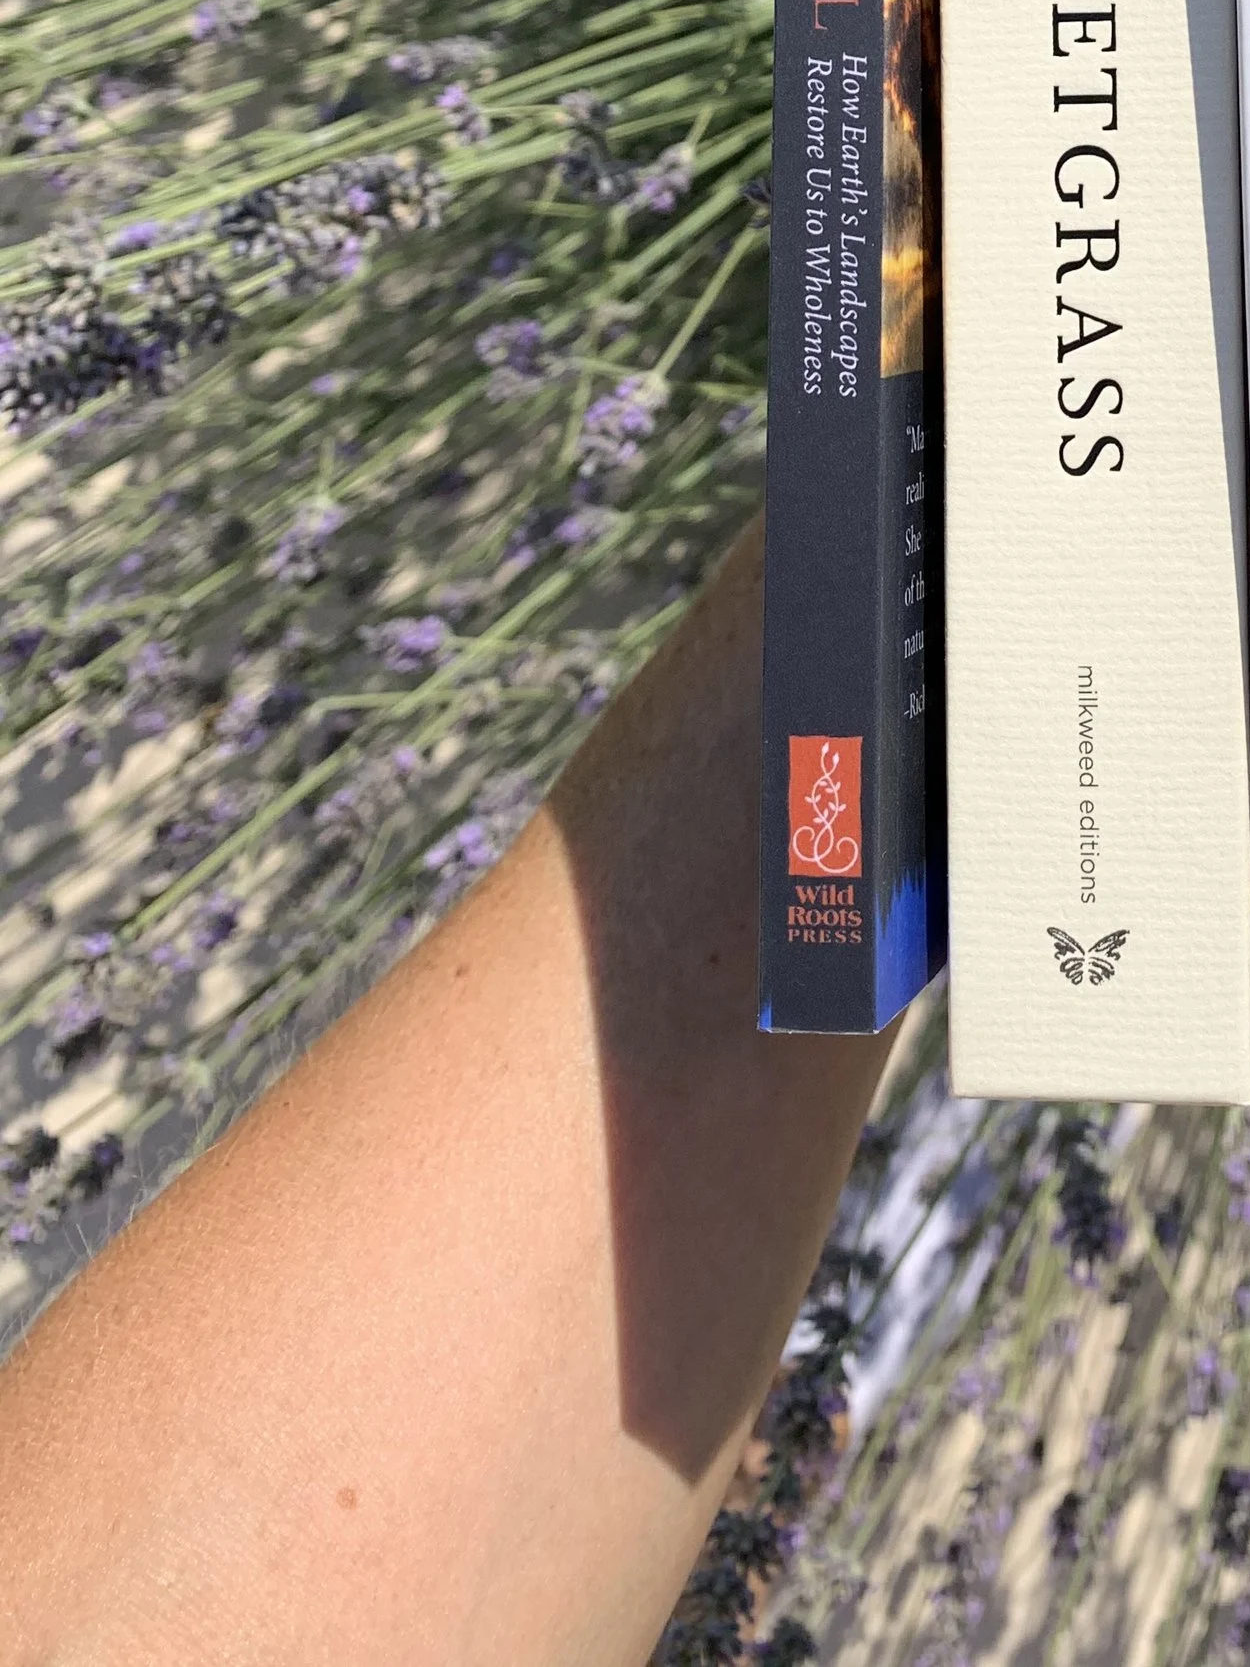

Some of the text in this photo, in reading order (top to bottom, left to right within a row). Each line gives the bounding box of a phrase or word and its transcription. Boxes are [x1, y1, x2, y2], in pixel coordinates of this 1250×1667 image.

[804, 58, 833, 394] Restore Us to Wholeness
[831, 53, 868, 397] How Earth’s Landscapes
[904, 574, 916, 607] of
[1077, 665, 1099, 903] milkweed editions
[795, 884, 854, 906] Wild
[788, 906, 862, 927] Roots
[788, 929, 862, 943] PRESS
